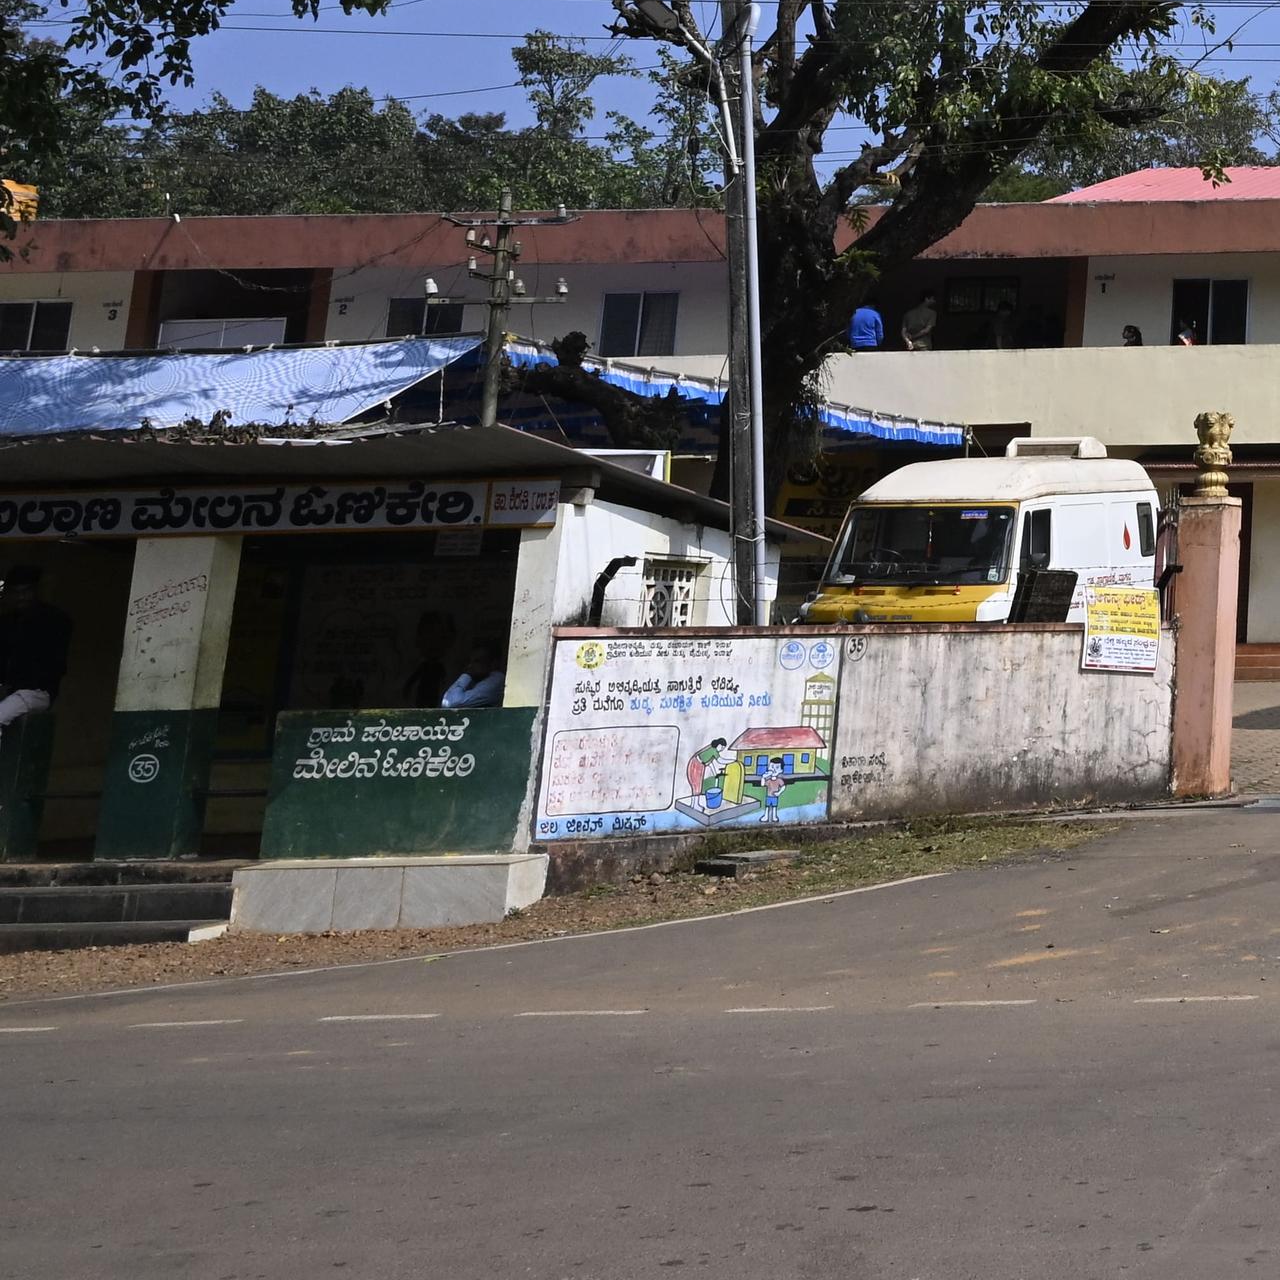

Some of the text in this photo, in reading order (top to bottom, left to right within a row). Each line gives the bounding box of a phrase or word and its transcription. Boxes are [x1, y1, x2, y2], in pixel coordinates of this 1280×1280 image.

[108, 309, 117, 320] 3
[339, 304, 347, 315] 2
[849, 639, 863, 653] 35
[572, 698, 587, 715] ಪ್ರತಿ
[593, 695, 624, 711] ಮನೆಗೂ
[701, 693, 743, 708] ಕುಡಿಯುವ
[748, 690, 772, 708] ನೀರು
[307, 717, 470, 748] ಗ್ರಾಮ ಪಂಚಾಯತ
[133, 761, 154, 777] 35
[540, 815, 646, 834] ಜಲ ಜೀವನ್ ಮಿಷನ್
